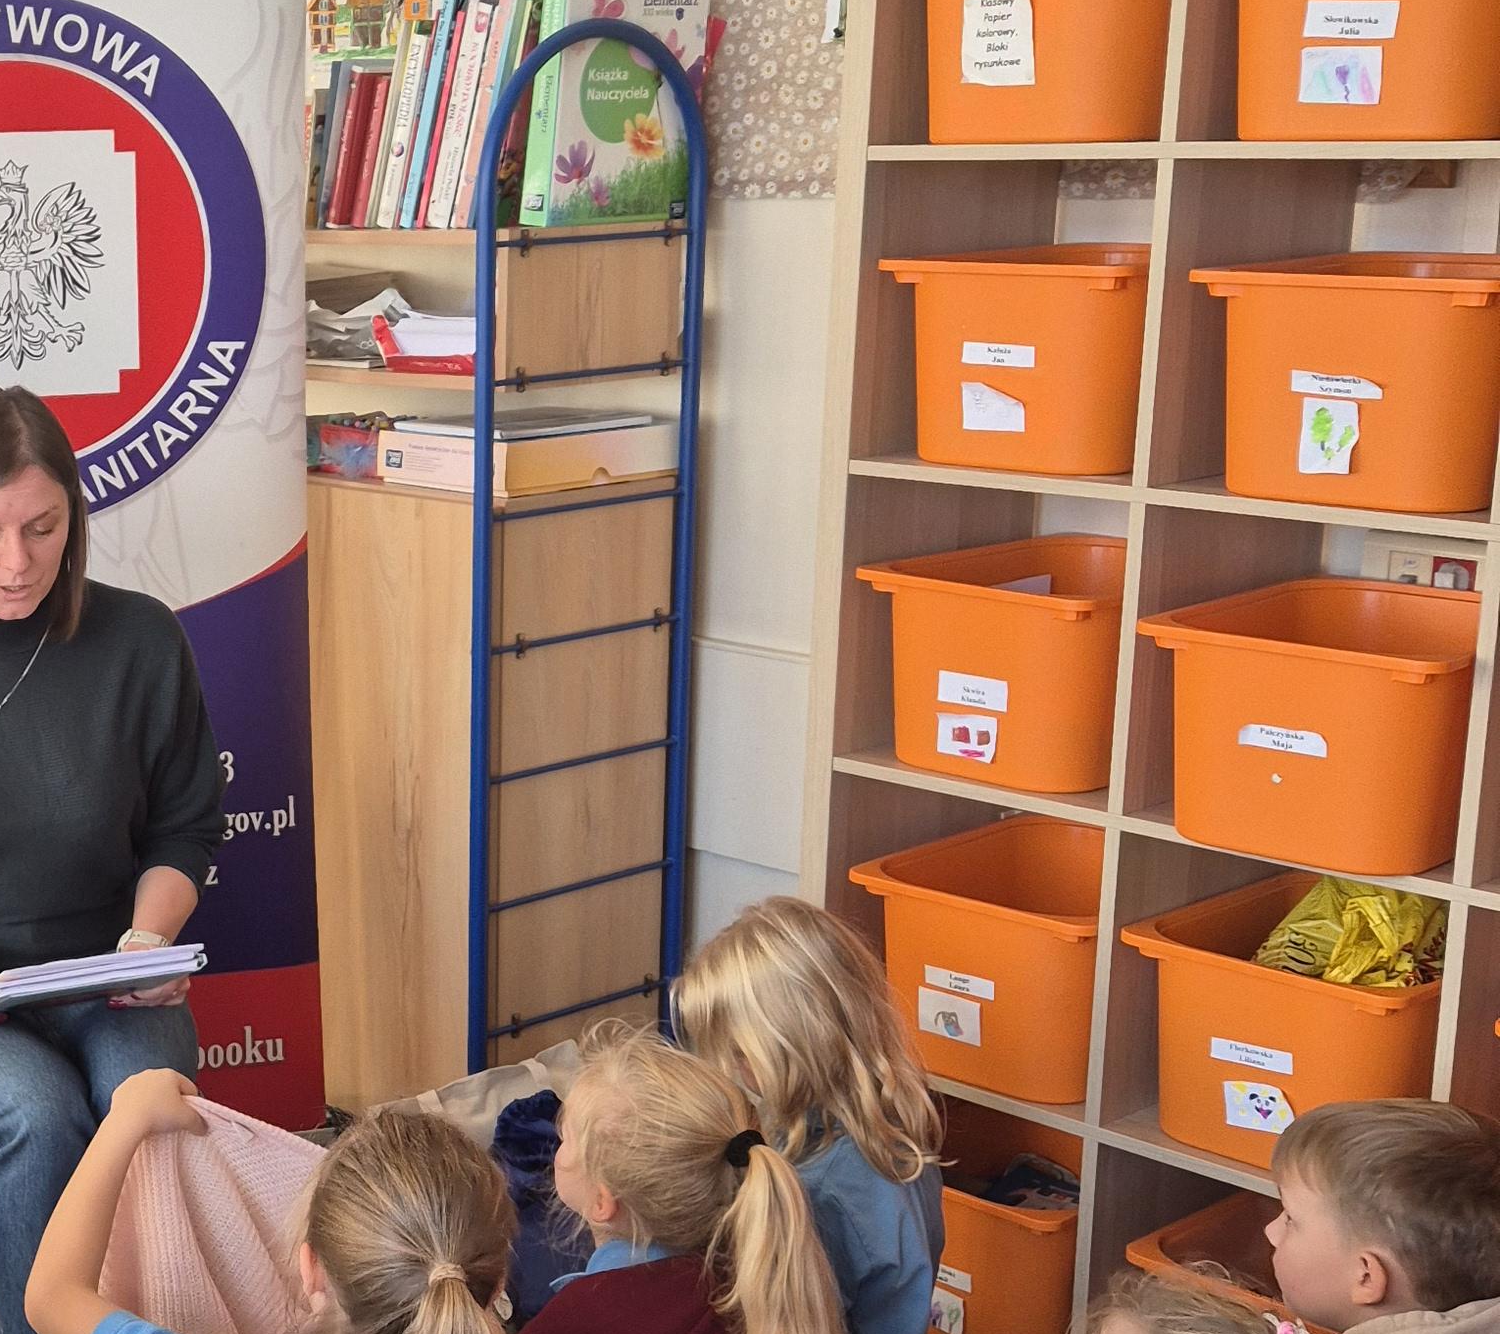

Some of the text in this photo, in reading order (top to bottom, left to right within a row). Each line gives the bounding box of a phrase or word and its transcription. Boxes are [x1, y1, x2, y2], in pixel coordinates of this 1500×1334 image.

[983, 12, 1012, 24] Papier
[1338, 27, 1360, 36] Julia
[986, 42, 1009, 53] Bloki
[973, 57, 1021, 70] rysunkowe
[587, 68, 629, 85] Książka
[395, 43, 422, 130] ENCYKLOPEDIA
[586, 85, 650, 103] Nauczyciela
[1272, 739, 1293, 750] Maja
[222, 794, 296, 841] gov.pl
[197, 1025, 285, 1070] ooku
